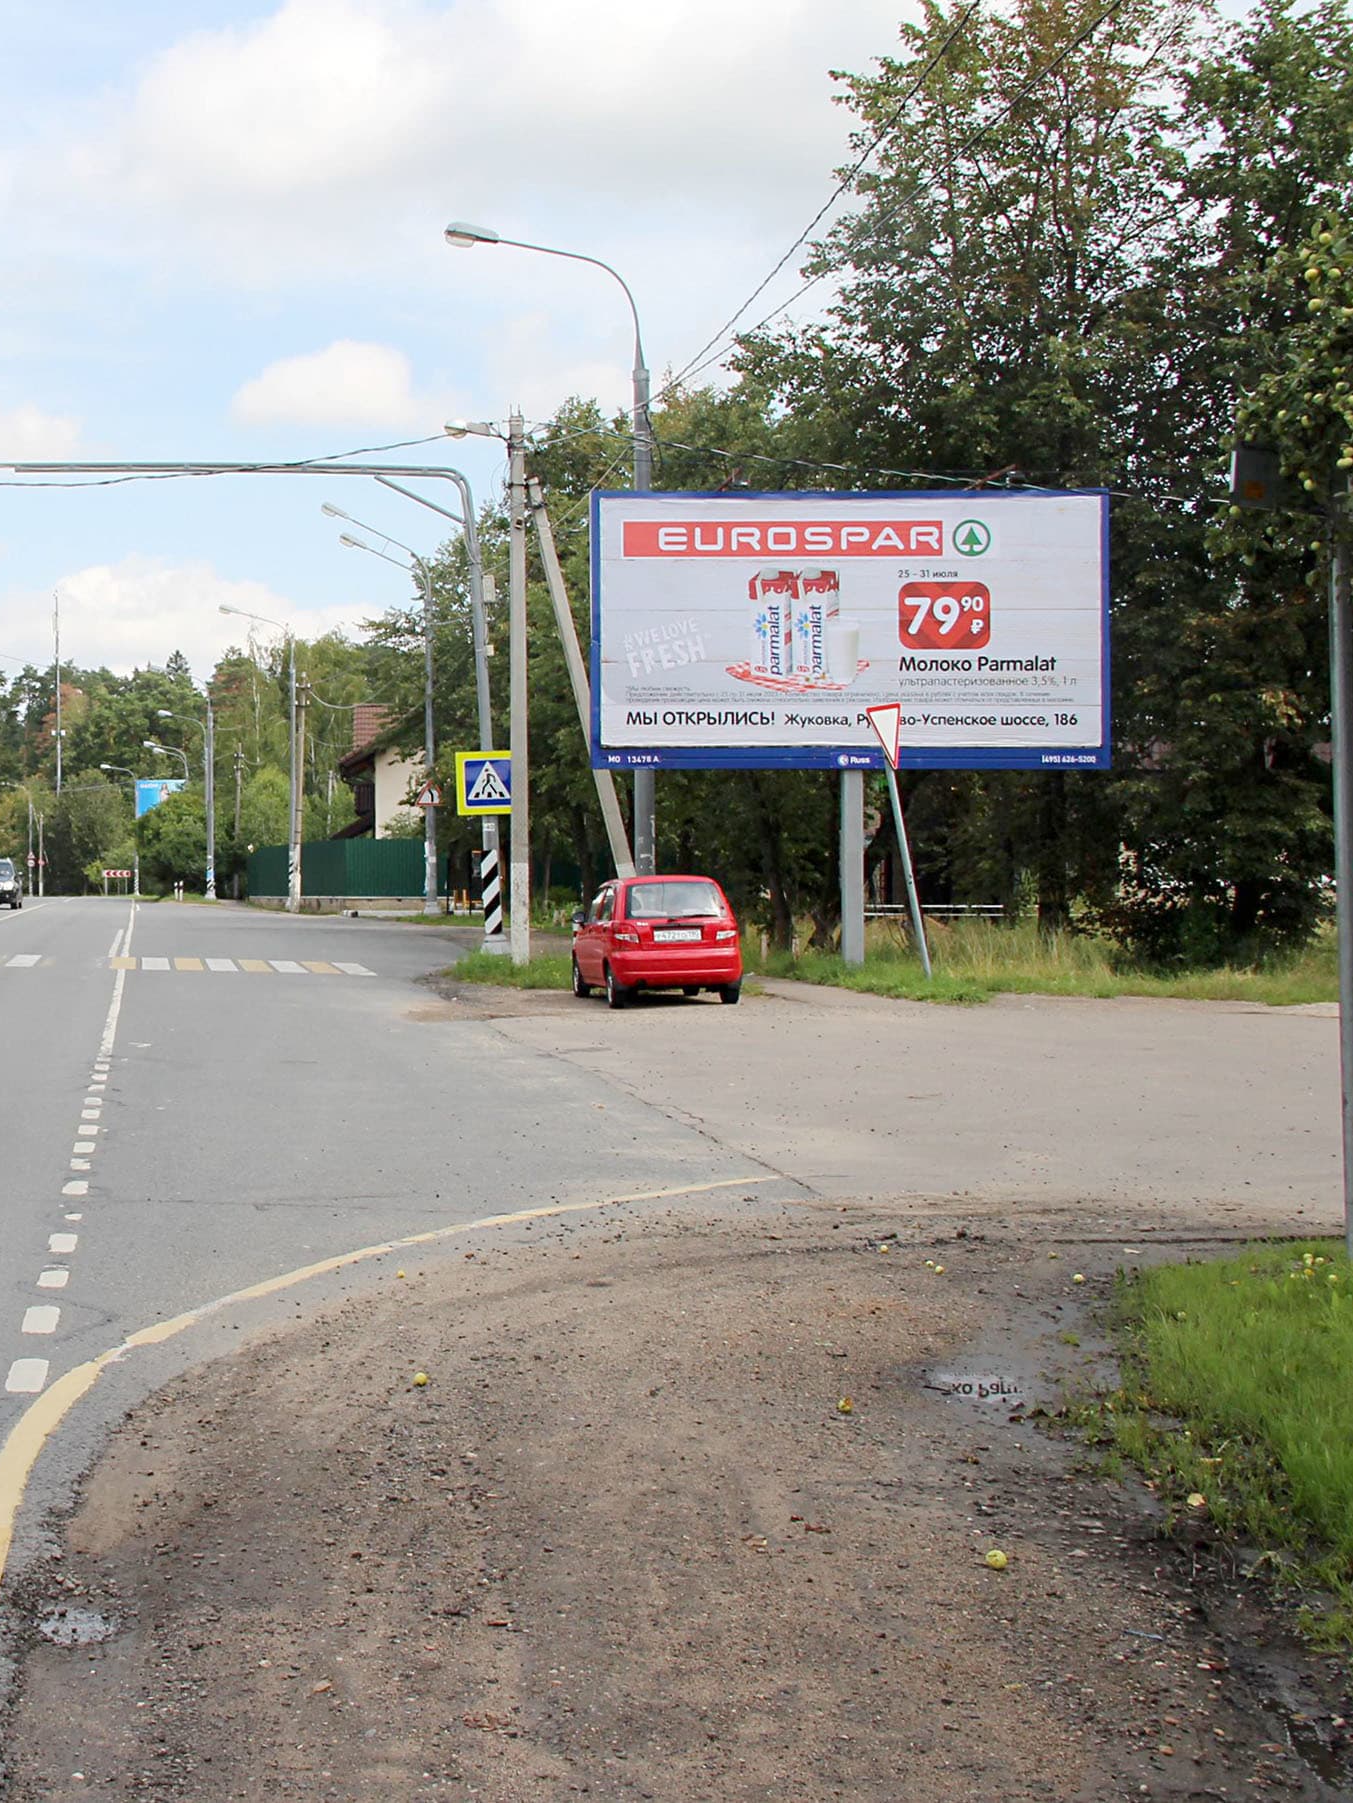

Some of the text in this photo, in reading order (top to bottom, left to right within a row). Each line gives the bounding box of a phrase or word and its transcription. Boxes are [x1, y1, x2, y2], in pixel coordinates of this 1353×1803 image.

[657, 526, 940, 551] EUROSPAR
[897, 570, 910, 578] 25
[920, 570, 930, 578] 31
[904, 596, 961, 635] 79
[961, 596, 984, 612] 90
[661, 617, 699, 640] LOVE
[767, 605, 783, 676] parmalat
[626, 634, 707, 678] FRESH
[899, 655, 1057, 672] Молоко Parmalat
[898, 677, 1028, 687] ультрапастеризованное
[626, 711, 1078, 728] МЫ ОТКРЫЛИСЬ! Жуковка, Руво-Успенское шоссе, 186
